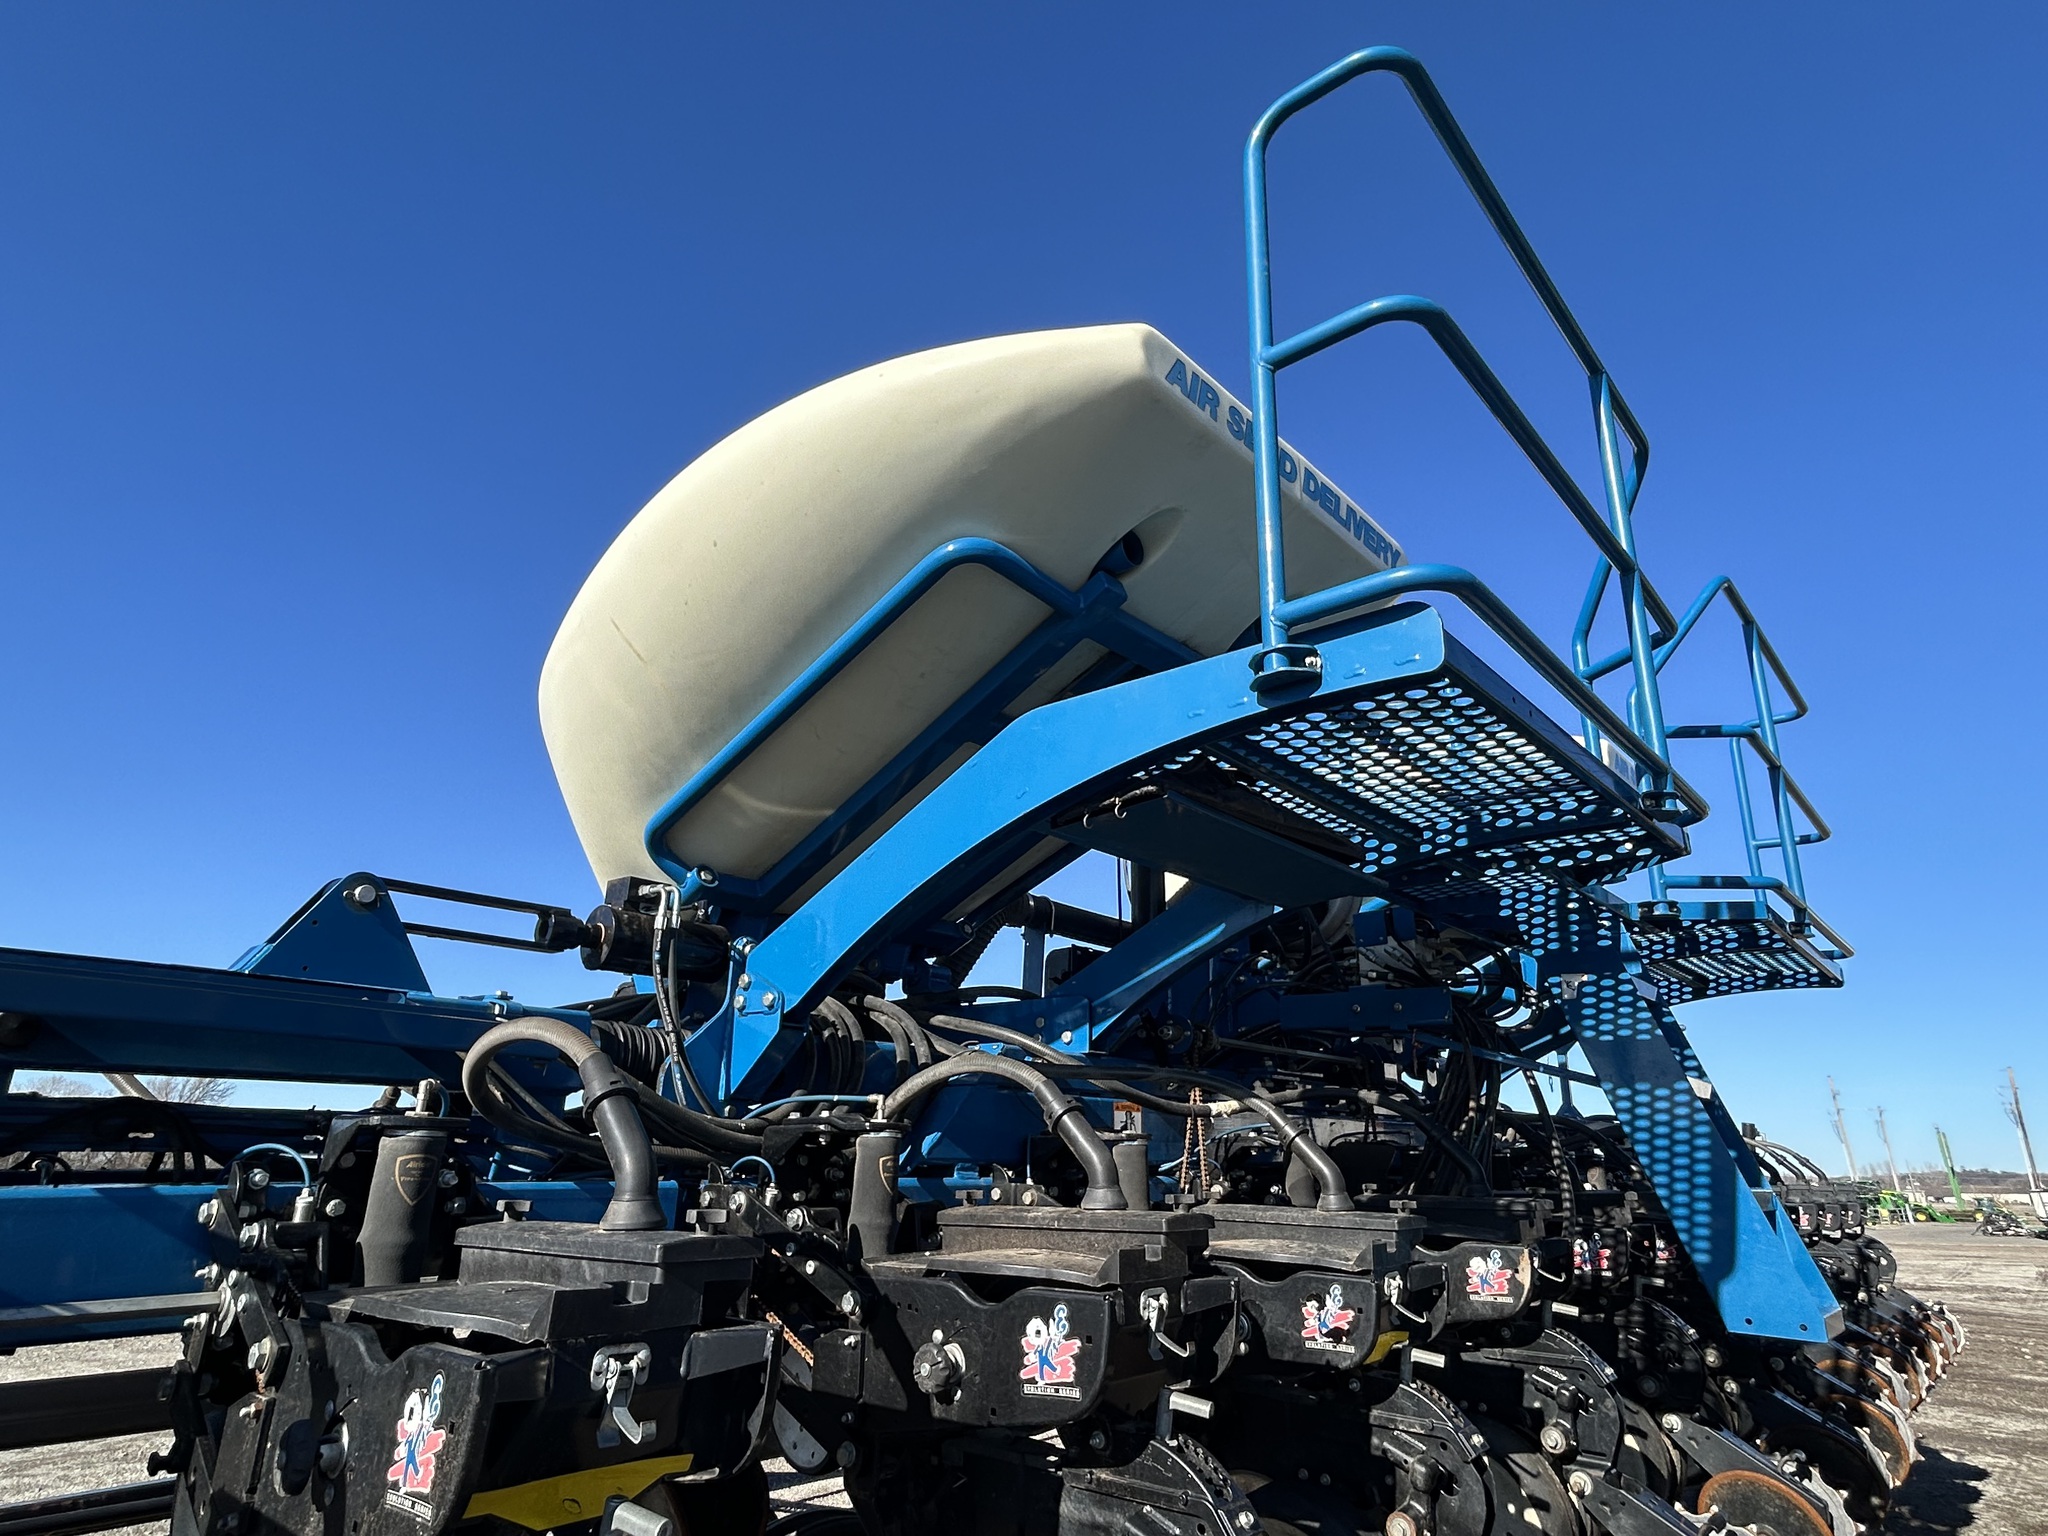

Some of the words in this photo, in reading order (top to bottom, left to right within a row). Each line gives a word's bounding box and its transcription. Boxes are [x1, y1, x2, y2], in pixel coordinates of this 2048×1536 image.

[1165, 358, 1220, 422] AIR
[1226, 405, 1298, 484] SED
[1302, 467, 1401, 569] DELIVERY
